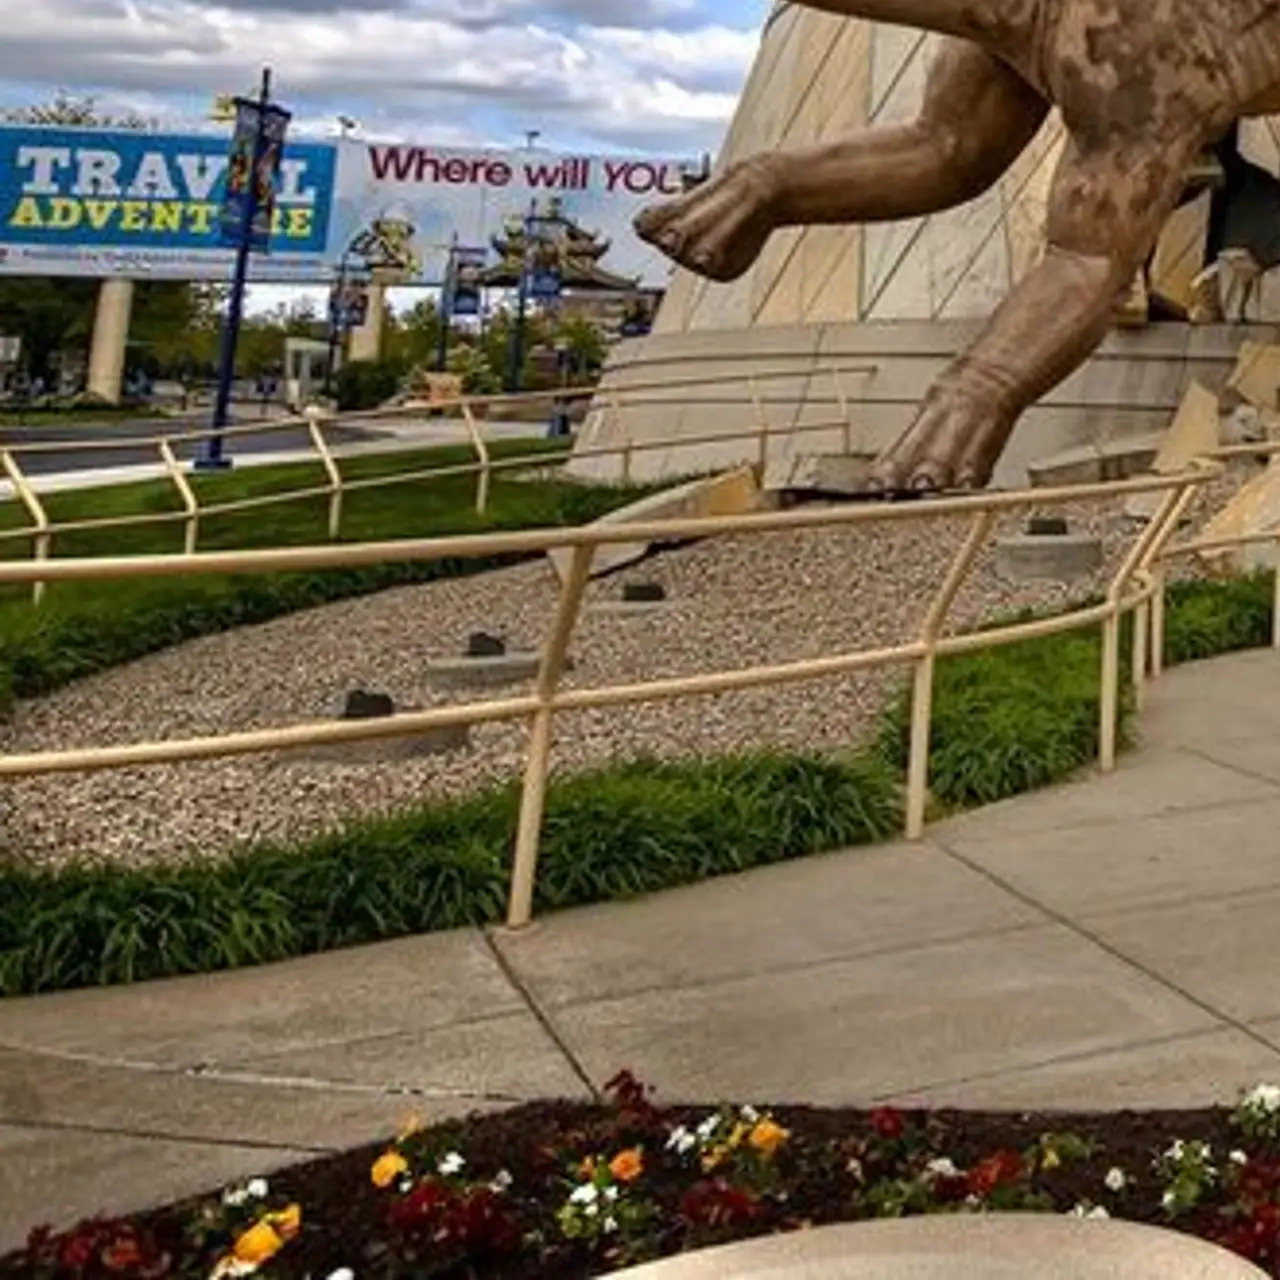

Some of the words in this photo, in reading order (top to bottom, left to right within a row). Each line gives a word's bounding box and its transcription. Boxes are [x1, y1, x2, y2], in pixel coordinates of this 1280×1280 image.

[16, 145, 316, 204] TRAVL
[368, 146, 513, 187] Where
[523, 157, 590, 190] will
